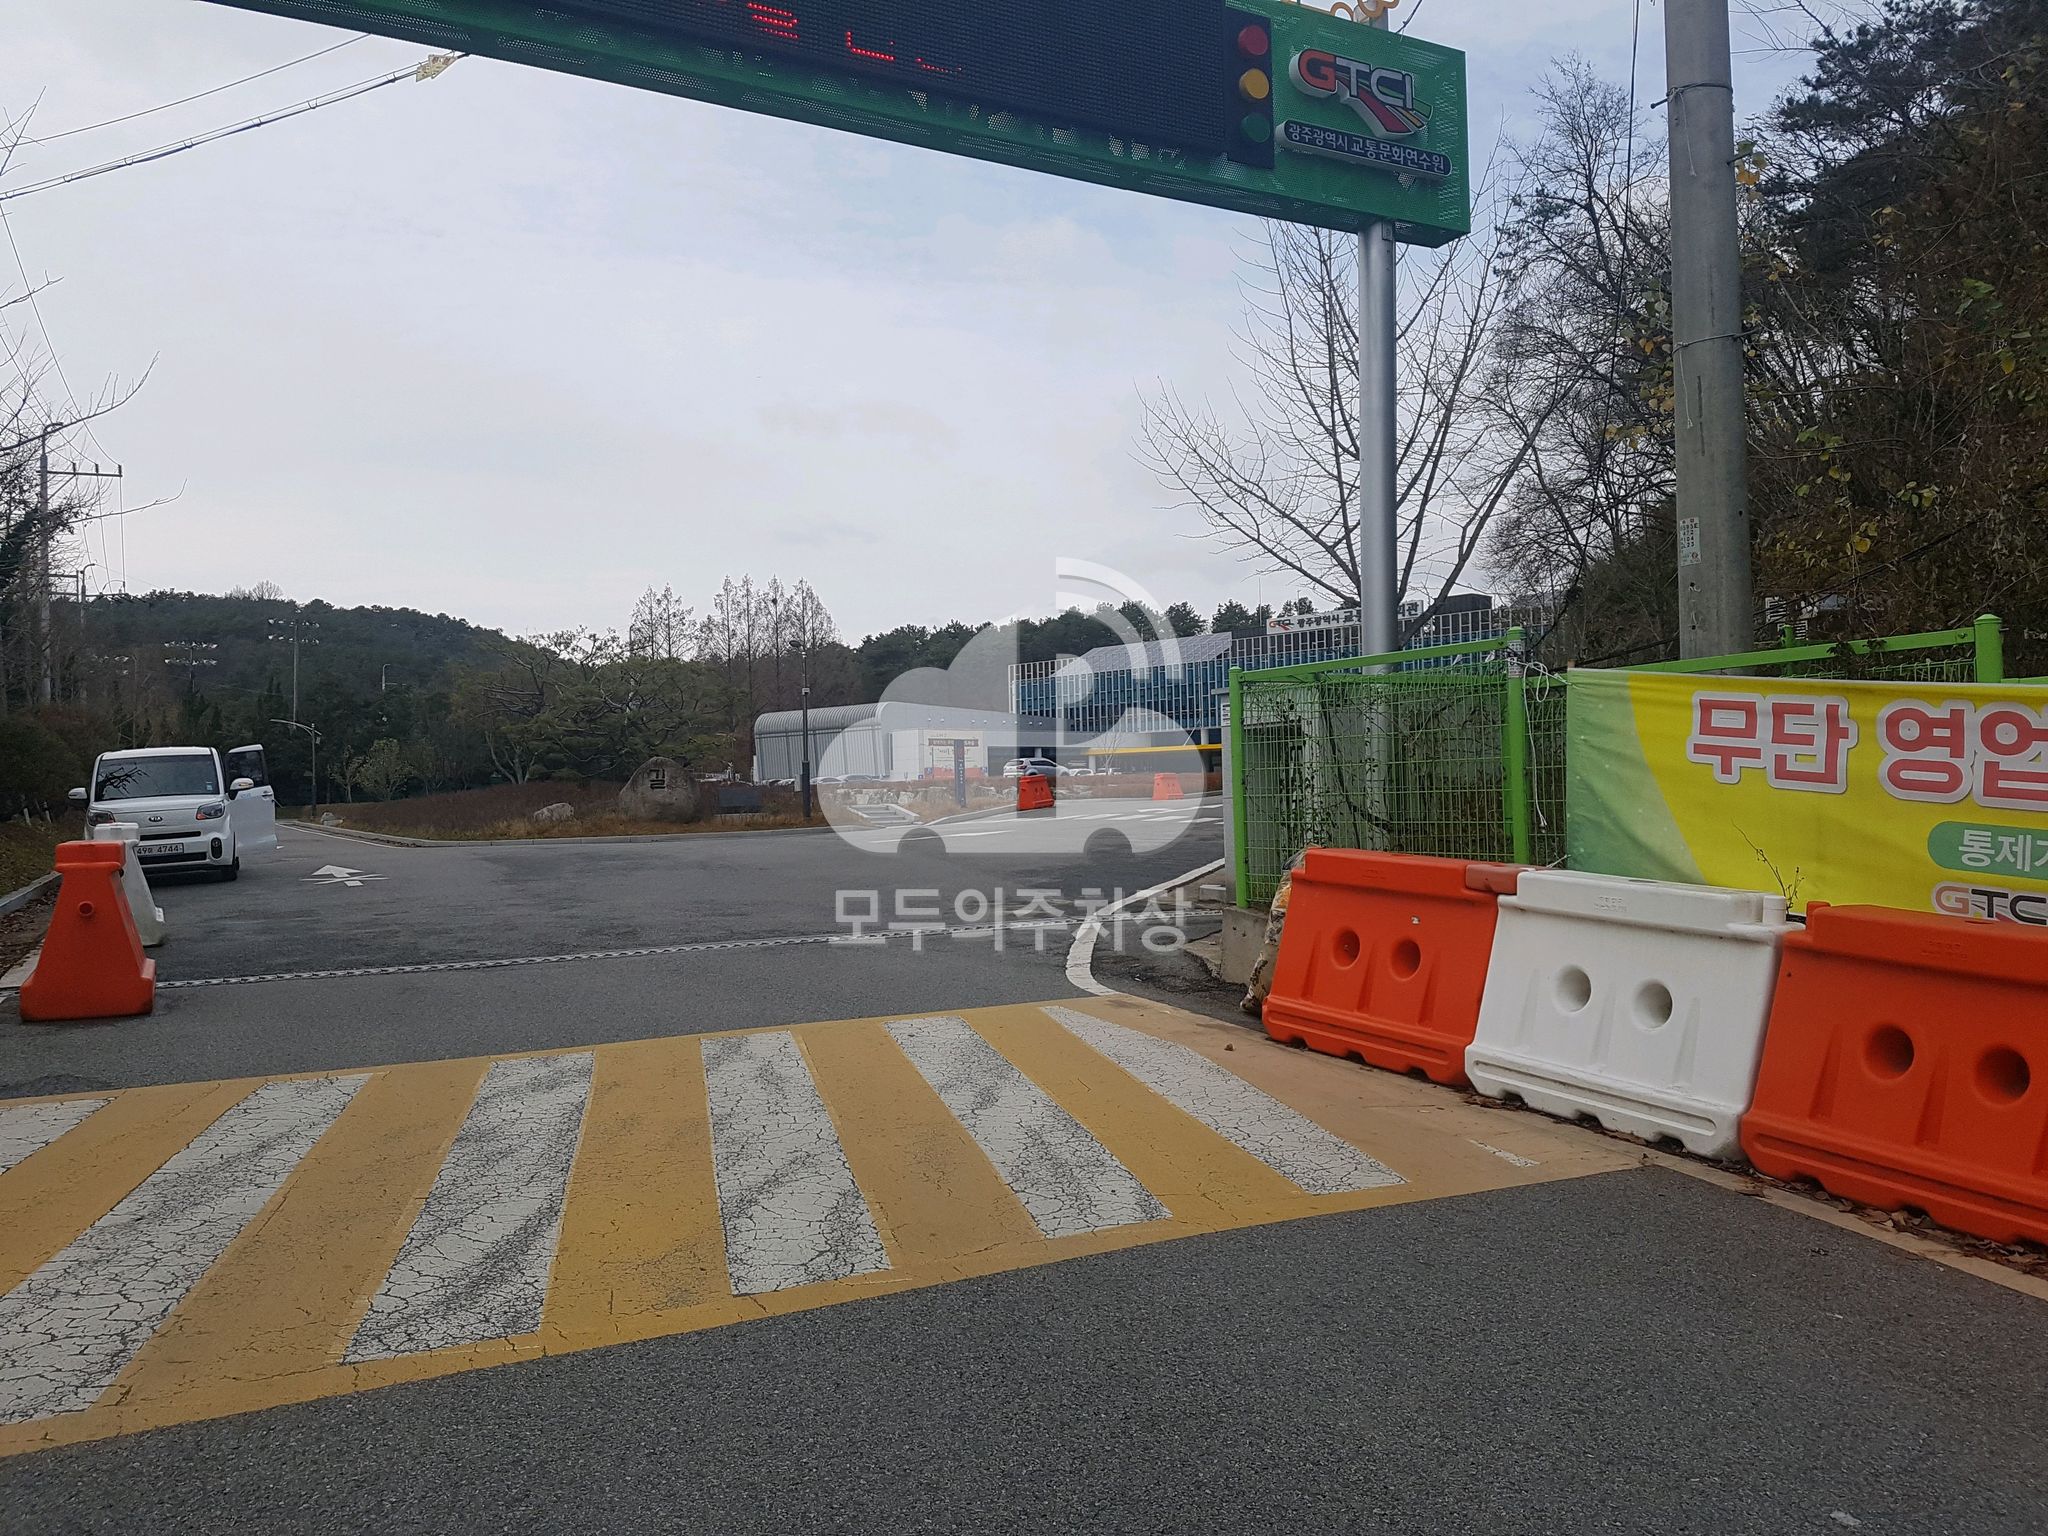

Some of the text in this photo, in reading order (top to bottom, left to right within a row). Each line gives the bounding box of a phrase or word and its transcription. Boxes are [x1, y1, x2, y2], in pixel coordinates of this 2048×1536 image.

[1297, 49, 1414, 110] GTCI
[1288, 122, 1445, 174] 광주광역시 교통문화연수원
[1296, 613, 1341, 629] 광주광역시
[1690, 695, 1853, 788] 무단
